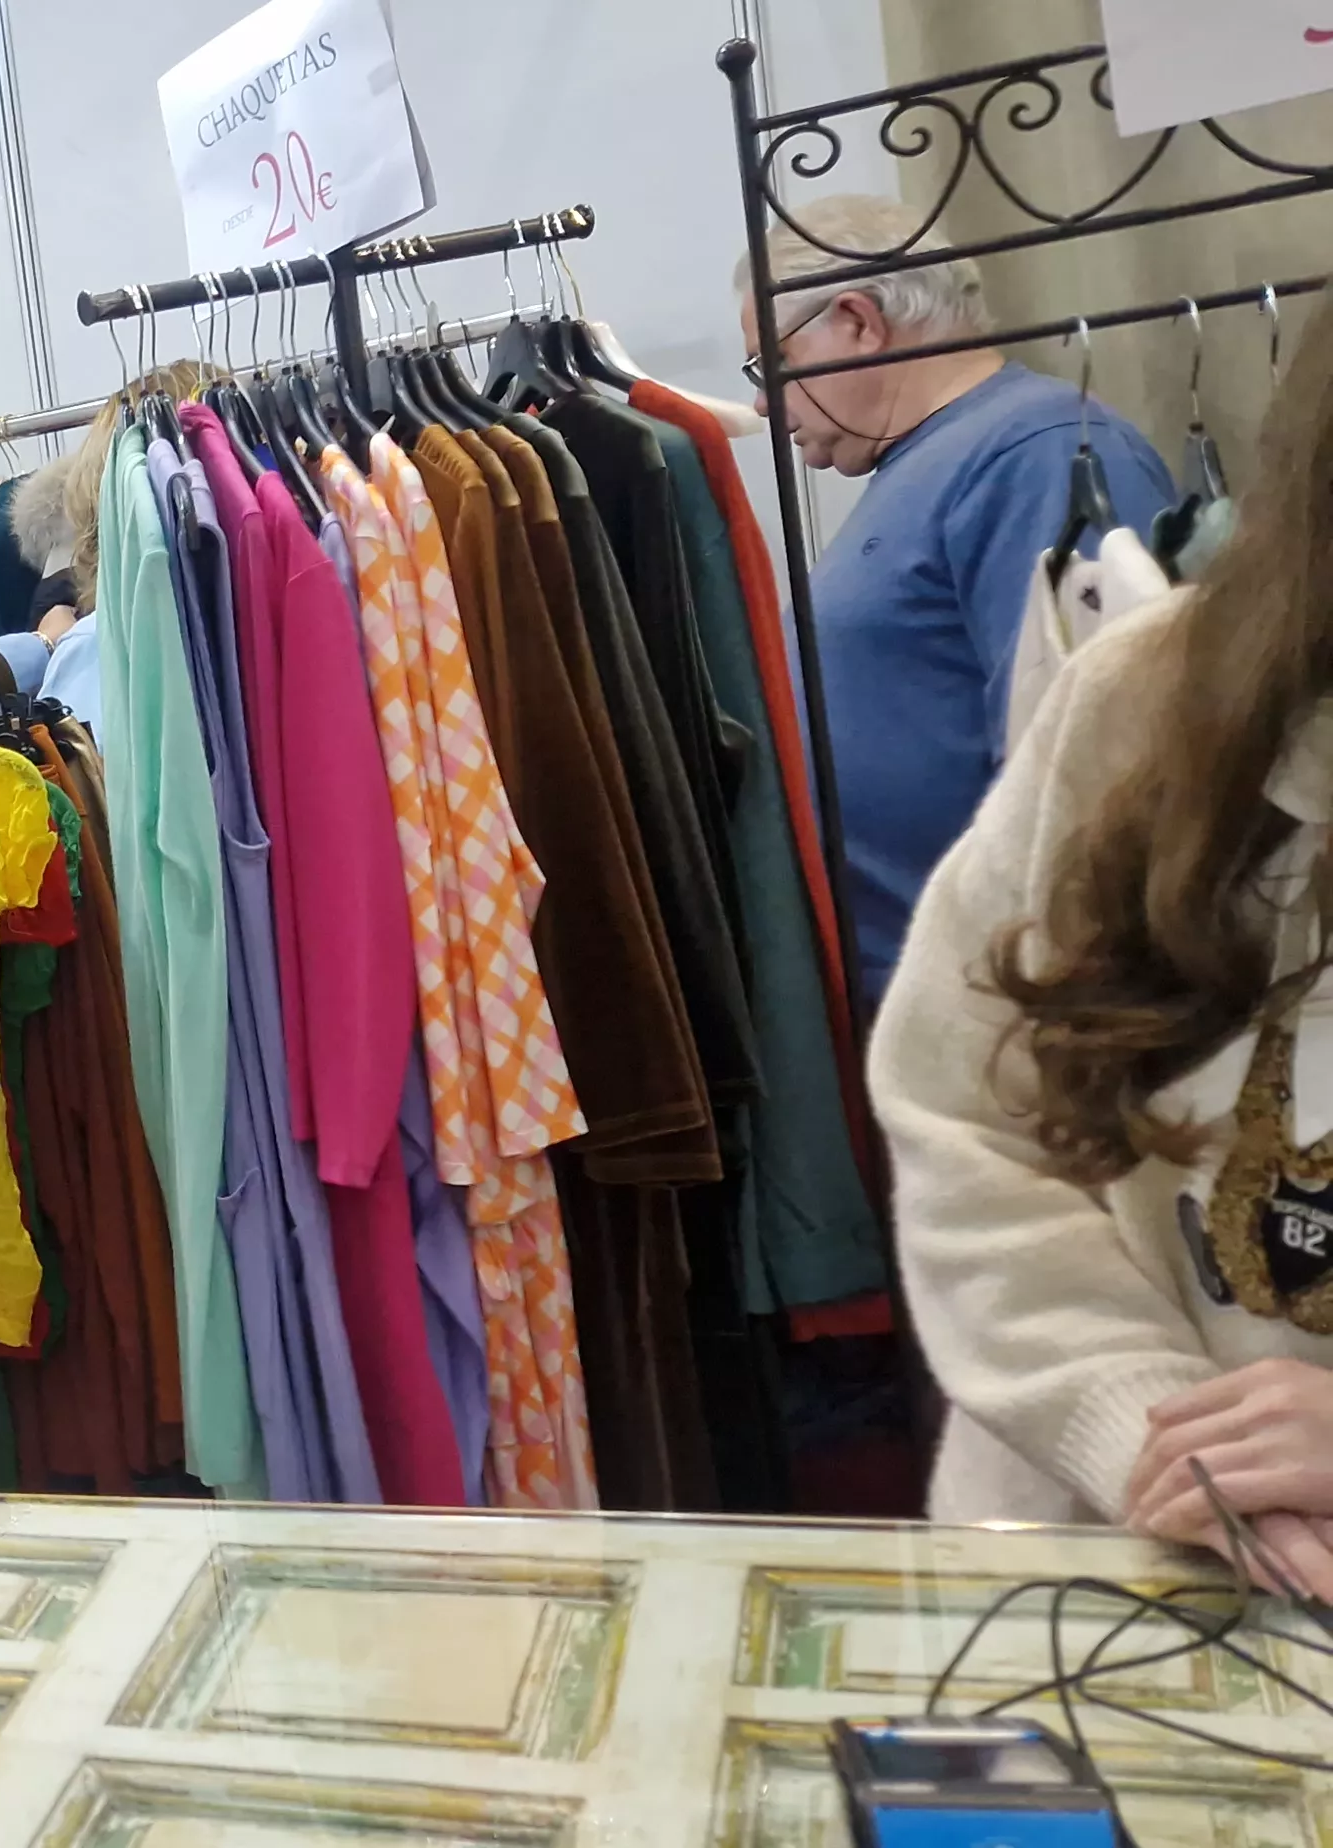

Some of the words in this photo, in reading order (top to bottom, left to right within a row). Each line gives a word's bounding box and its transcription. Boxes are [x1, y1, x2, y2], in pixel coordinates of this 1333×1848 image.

[197, 32, 337, 148] CHAQUETAS
[222, 204, 254, 234] DESDE
[252, 130, 338, 249] 20€
[1282, 1214, 1326, 1257] 82
